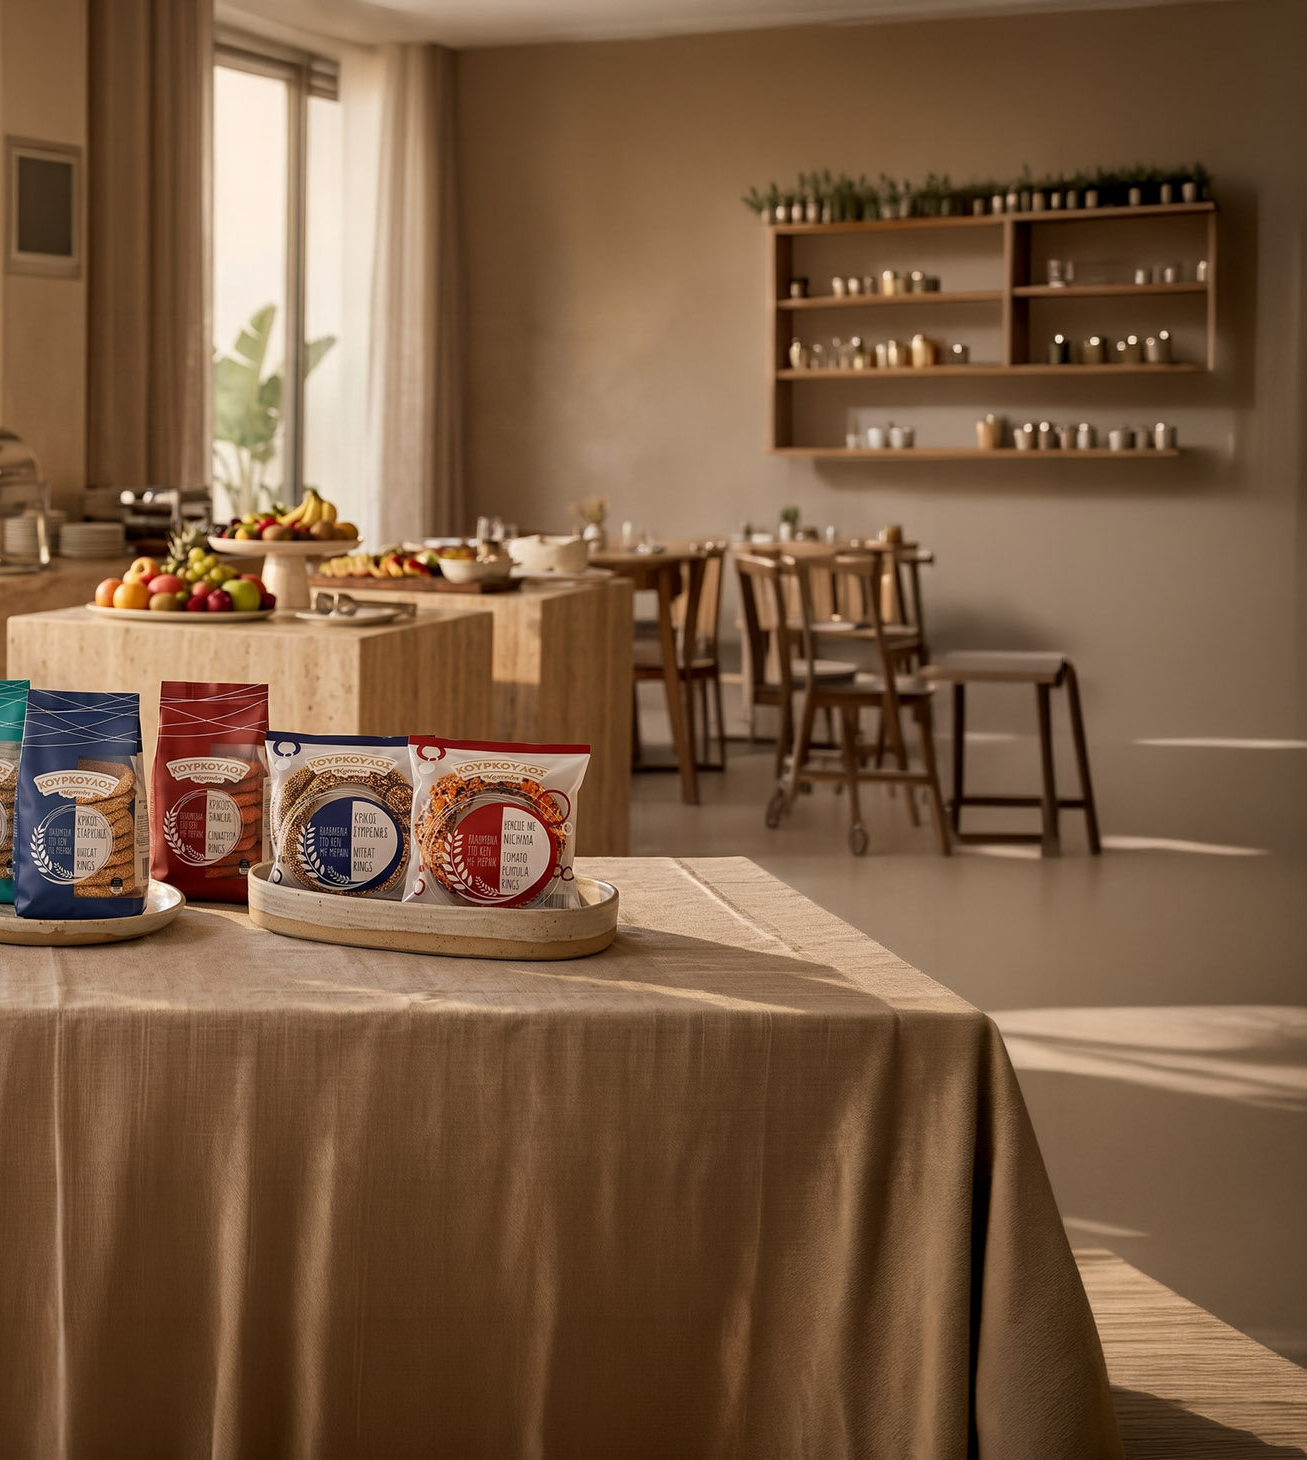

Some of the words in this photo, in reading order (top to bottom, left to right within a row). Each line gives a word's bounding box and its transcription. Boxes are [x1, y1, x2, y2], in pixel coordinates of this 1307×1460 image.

[310, 756, 393, 770] ΚΟΥΡΚΟΥΛΟΣ
[171, 762, 246, 777] ΚΟΥΡΚΟΥΛΟΣ
[455, 762, 548, 777] ΚΟΥΡΚΟΥΛΟΣ
[38, 776, 114, 791] ΚΟΥΡΚΟΥΛΟΣ
[208, 843, 225, 854] RINGS
[503, 852, 528, 864] TOMATO
[76, 860, 95, 871] RINGS
[353, 861, 373, 873] RINGS
[501, 878, 520, 890] RINGS
